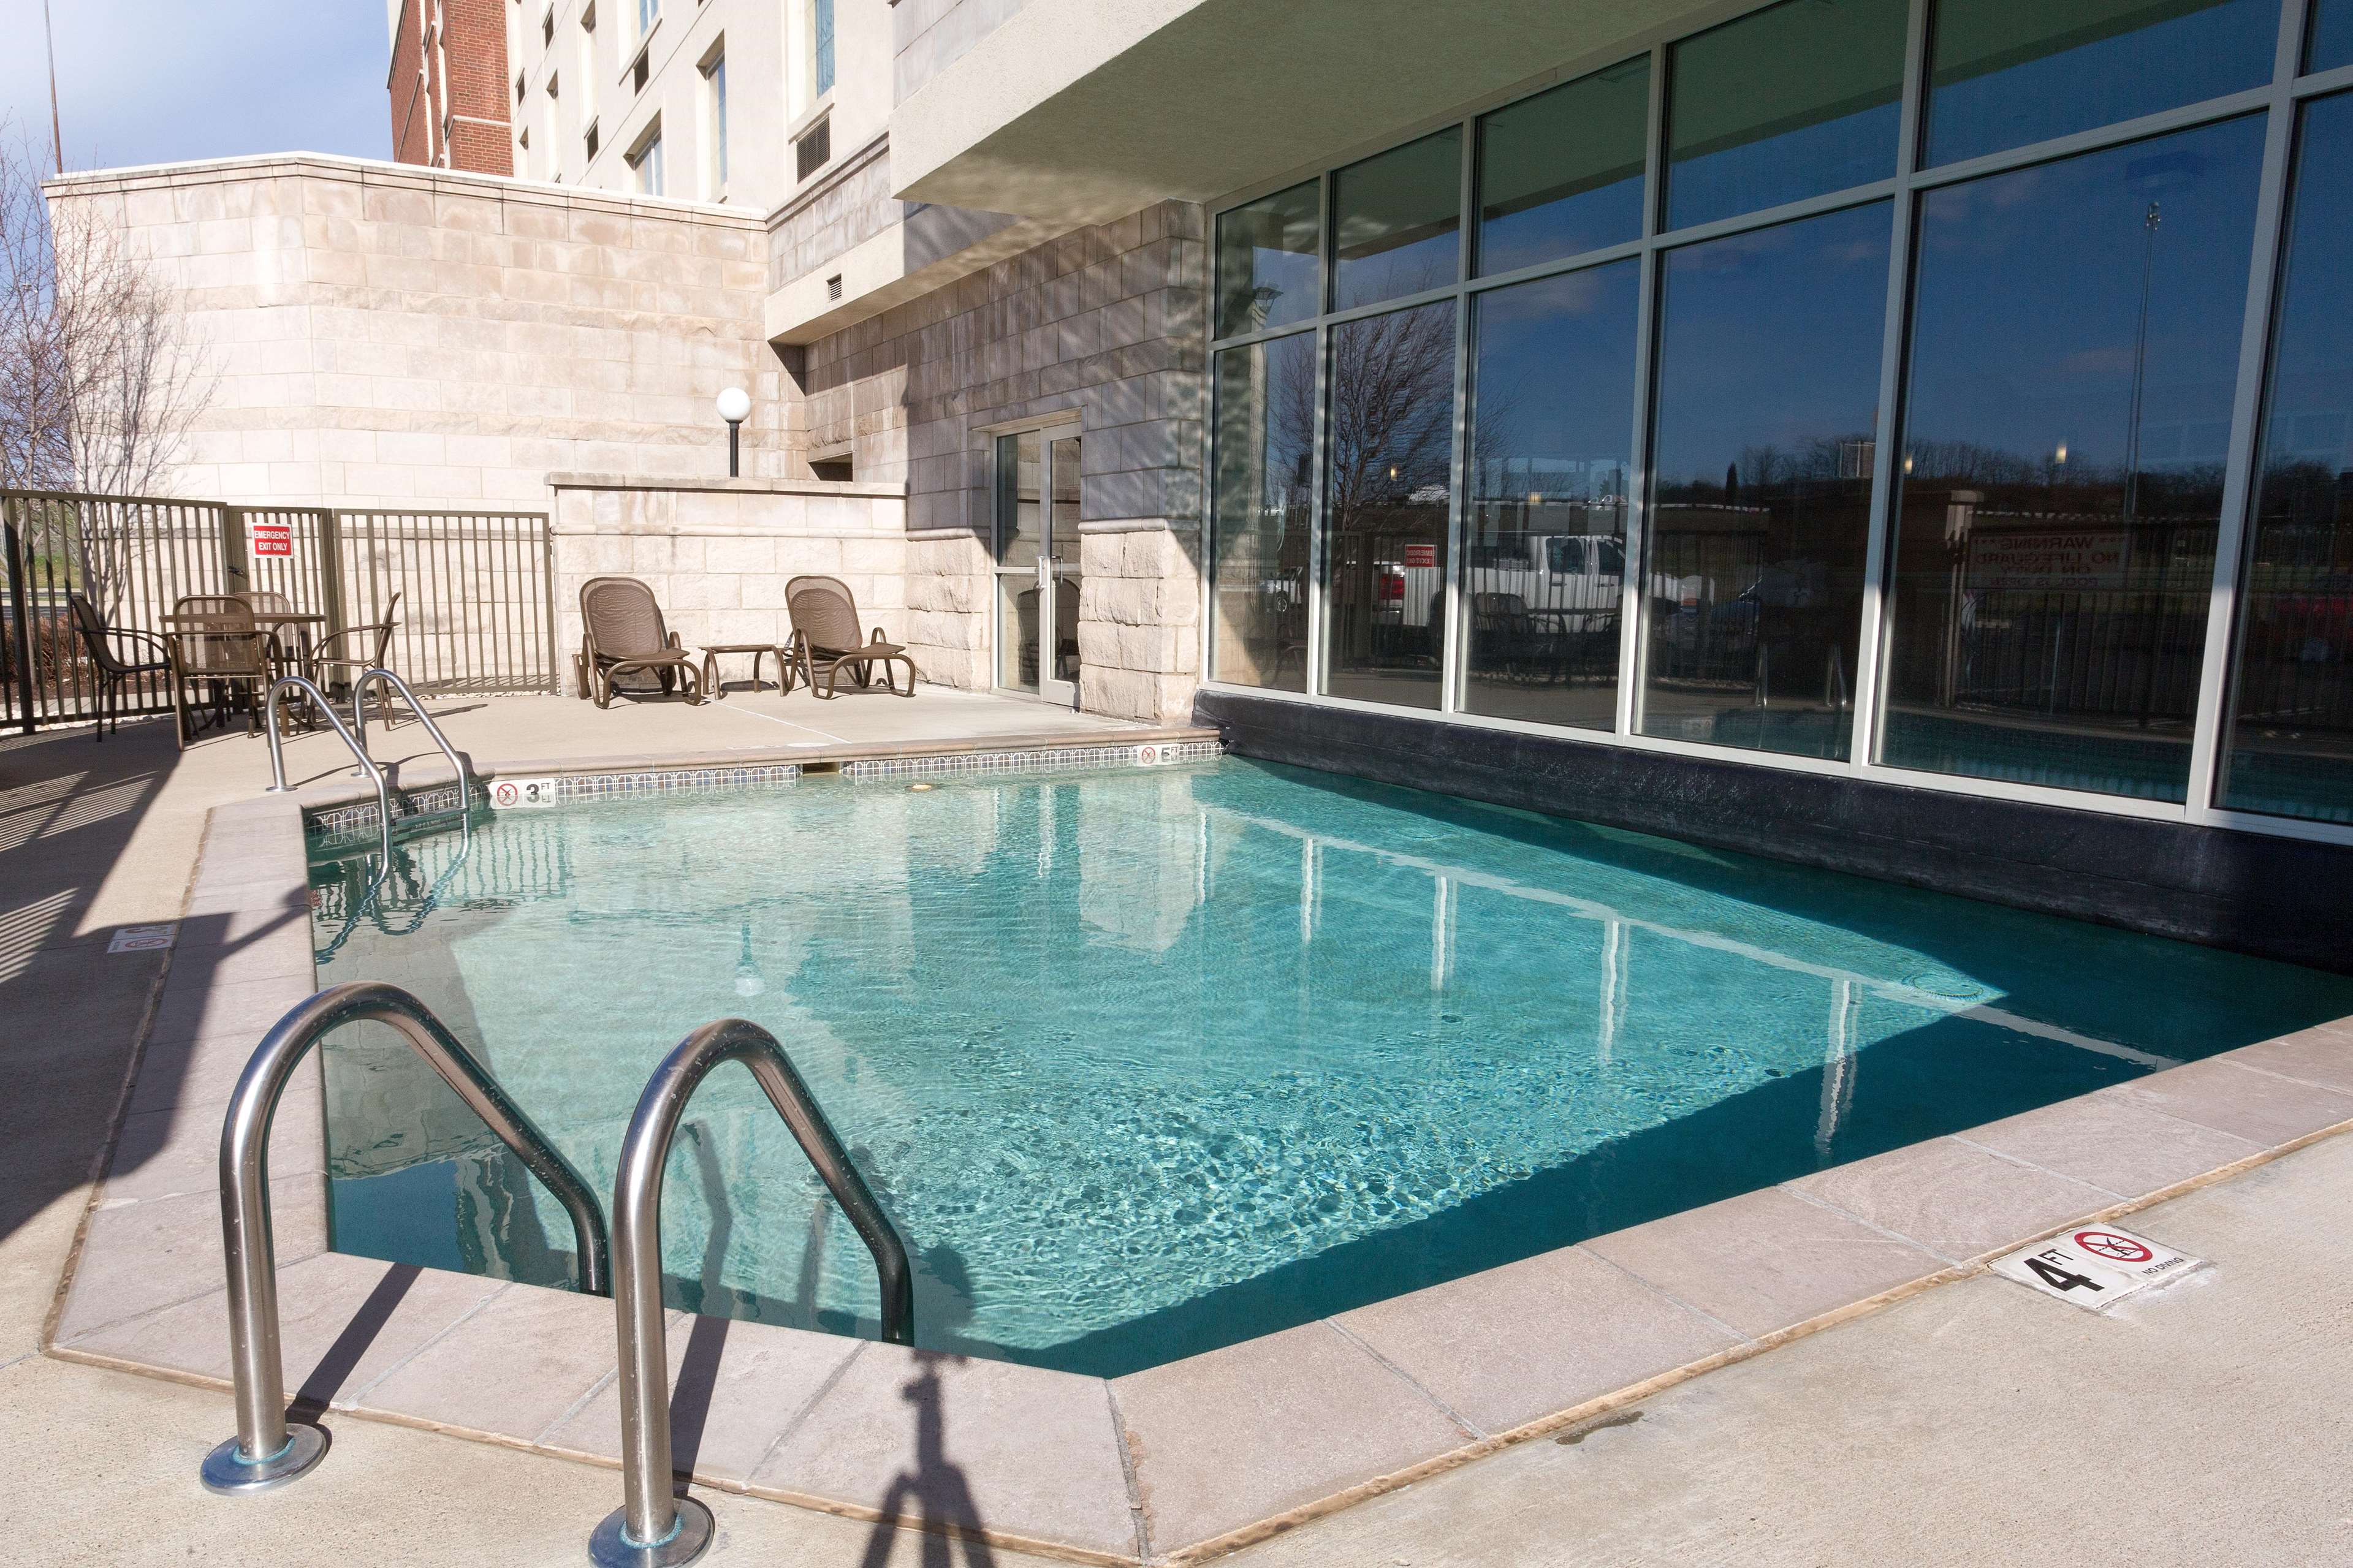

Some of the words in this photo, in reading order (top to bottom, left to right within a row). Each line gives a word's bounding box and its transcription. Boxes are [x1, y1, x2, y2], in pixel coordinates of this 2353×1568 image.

[254, 531, 290, 539] EMERGENCY
[272, 542, 287, 551] ONLY
[526, 784, 539, 803] 3
[2038, 1248, 2074, 1265] FT
[2024, 1257, 2105, 1292] 4
[2142, 1265, 2157, 1276] NO
[2157, 1257, 2184, 1271] DIVING
